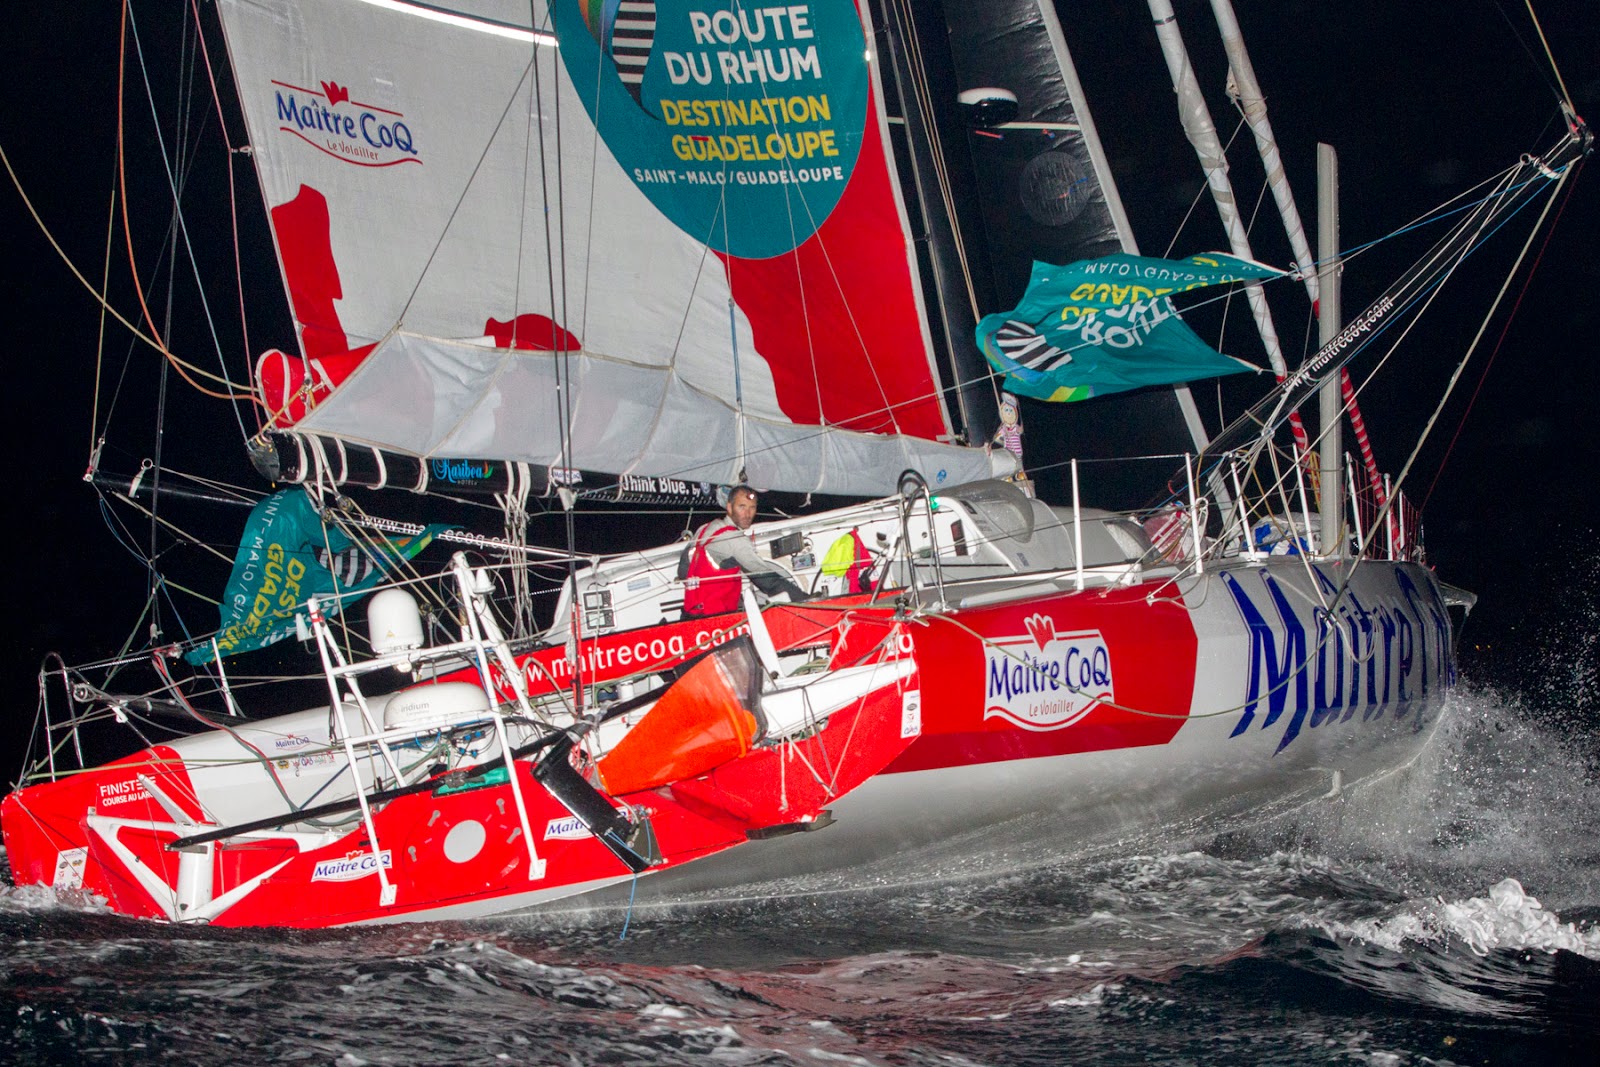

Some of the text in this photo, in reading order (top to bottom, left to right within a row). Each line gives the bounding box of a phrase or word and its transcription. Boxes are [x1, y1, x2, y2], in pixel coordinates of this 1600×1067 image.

[689, 5, 814, 44] ROUTE
[663, 45, 822, 85] DU RHUM
[275, 90, 418, 155] Maître CoQ
[660, 94, 832, 126] DESTINATION
[340, 140, 379, 161] Volailler
[671, 130, 839, 161] GUADELOUPE
[691, 483, 701, 498] by
[989, 646, 1111, 703] Maître CoQ
[1040, 699, 1075, 716] Volailler
[127, 792, 138, 802] AU
[315, 861, 359, 878] Maître
